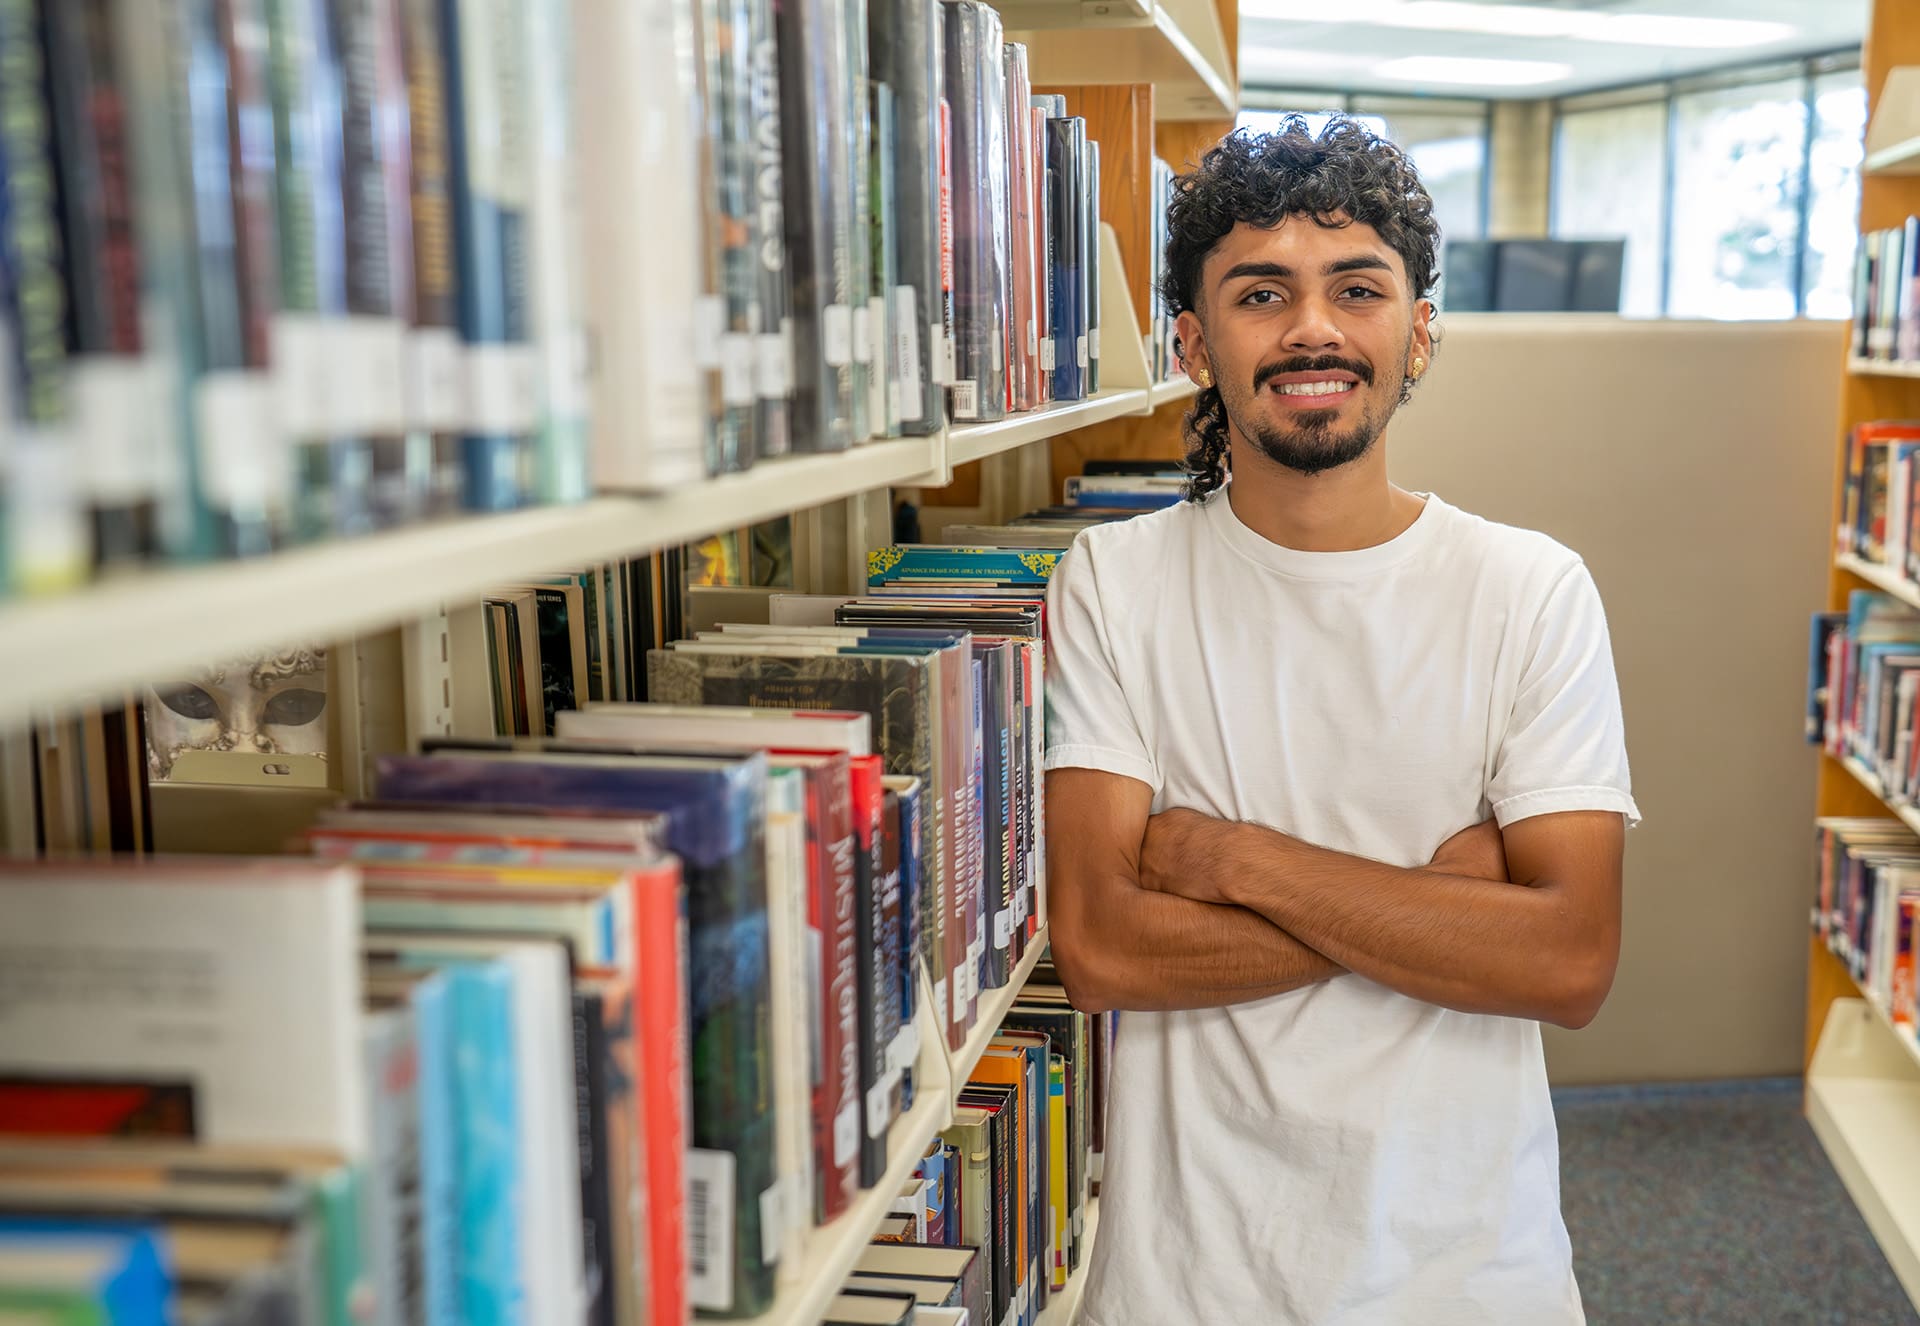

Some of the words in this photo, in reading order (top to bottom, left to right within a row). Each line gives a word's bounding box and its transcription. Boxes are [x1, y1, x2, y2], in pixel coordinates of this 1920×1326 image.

[942, 191, 953, 250] STEPHEN
[942, 252, 953, 287] KING
[1000, 727, 1009, 828] DESTINATION
[1001, 830, 1010, 907] UNKNOWN
[1016, 840, 1024, 887] THREE
[826, 833, 856, 998] MASTER
